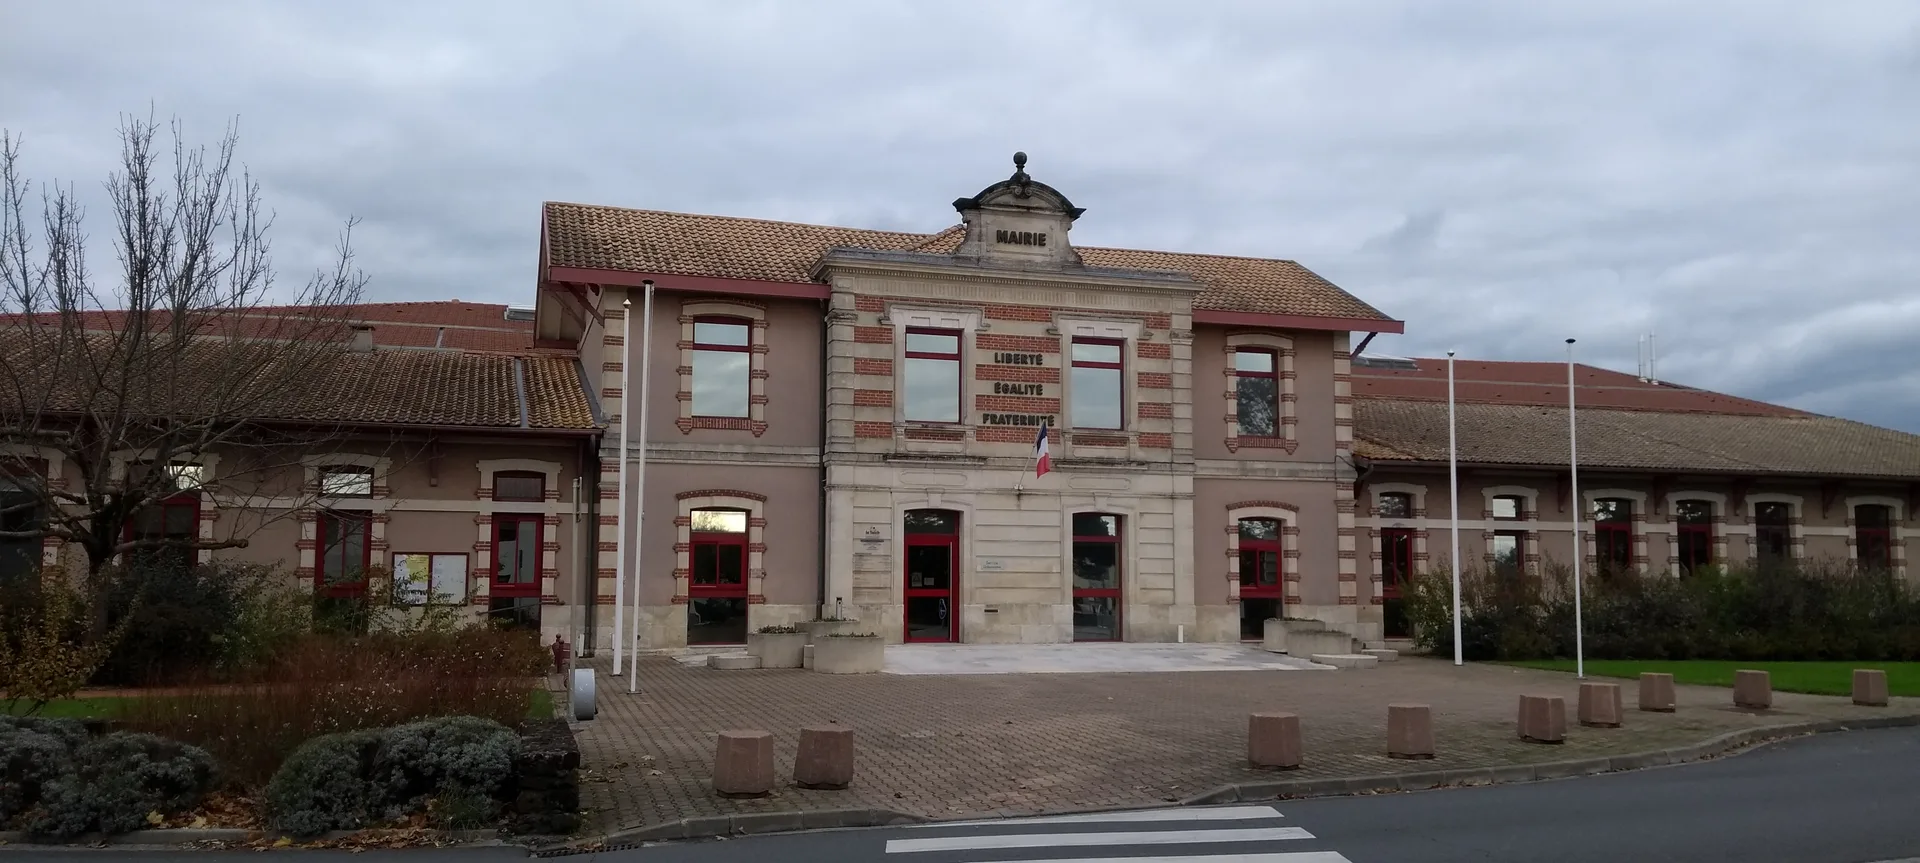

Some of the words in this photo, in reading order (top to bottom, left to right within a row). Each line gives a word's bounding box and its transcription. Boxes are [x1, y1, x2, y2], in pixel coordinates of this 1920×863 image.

[996, 229, 1047, 246] MAIRIE
[994, 352, 1043, 365] LIBERTÉ
[994, 382, 1043, 396] ÉGALITÉ
[982, 413, 1055, 427] FRATERNITÉ
